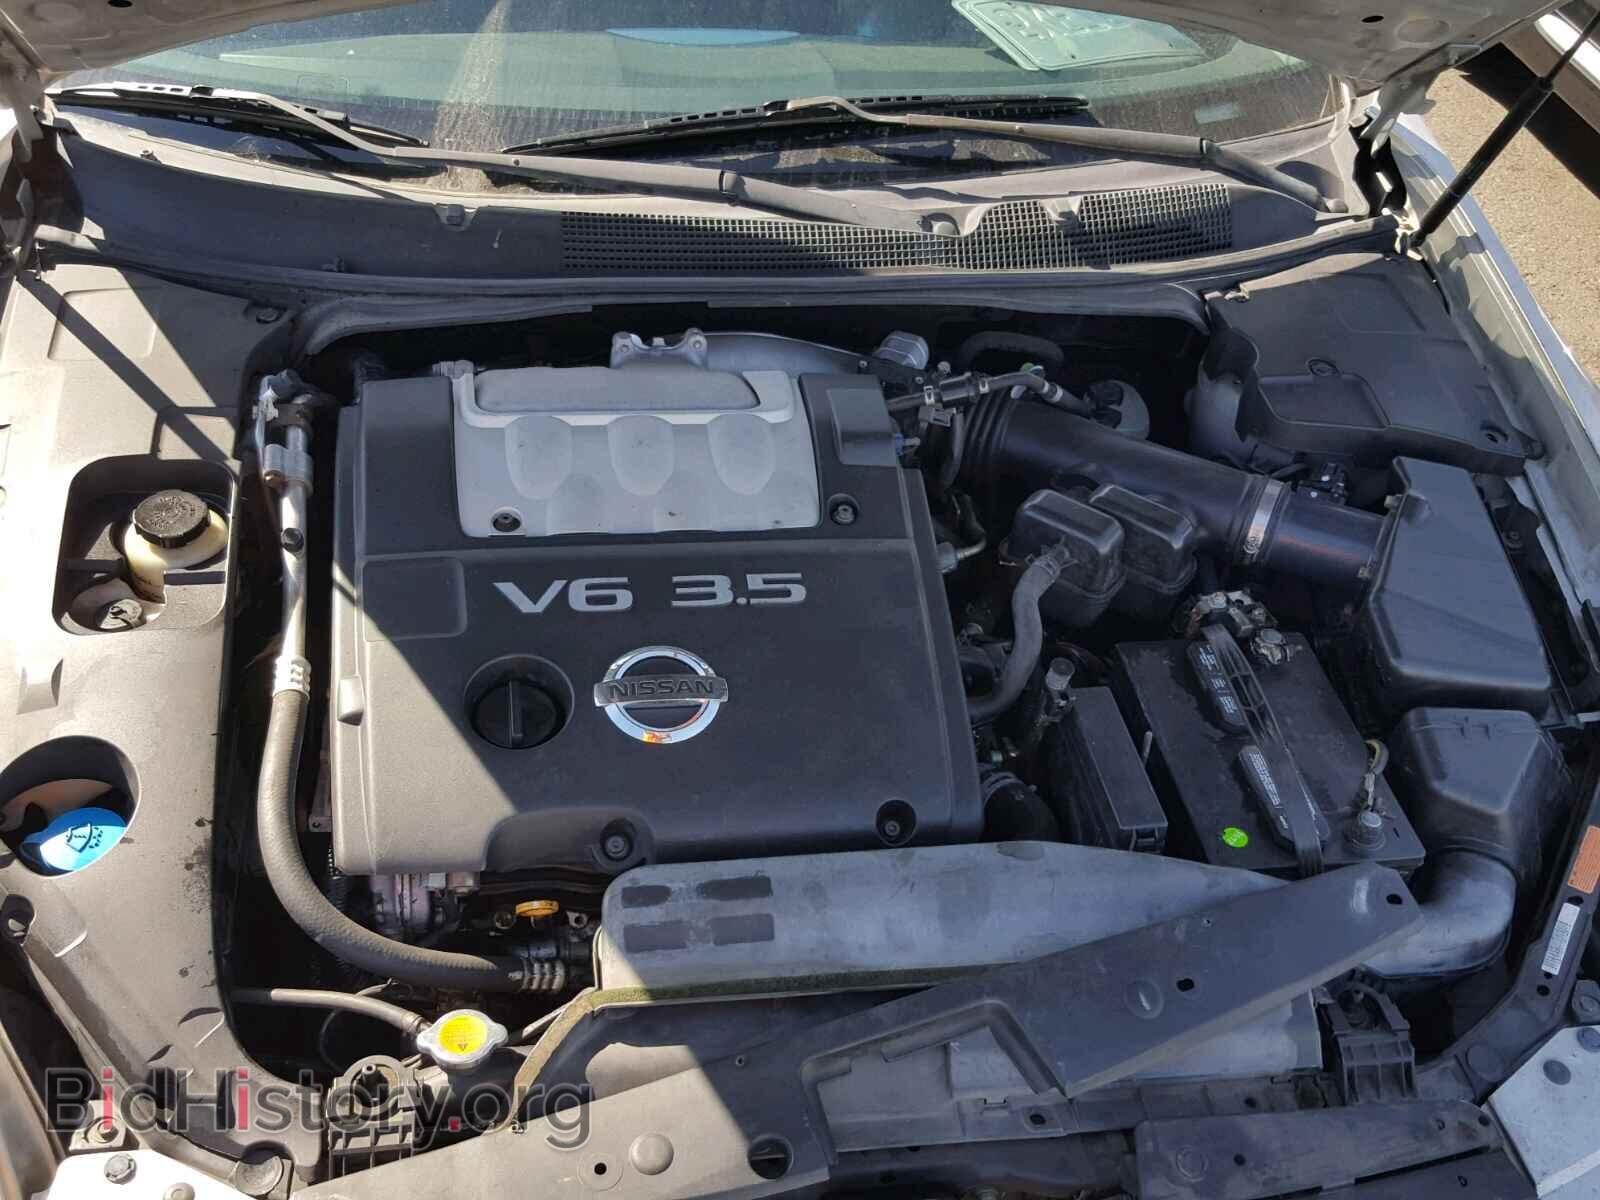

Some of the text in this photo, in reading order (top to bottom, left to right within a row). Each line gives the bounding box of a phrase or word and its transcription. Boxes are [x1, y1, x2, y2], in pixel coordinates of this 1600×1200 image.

[493, 572, 807, 614] V6 3.5
[608, 678, 714, 698] NISSAN
